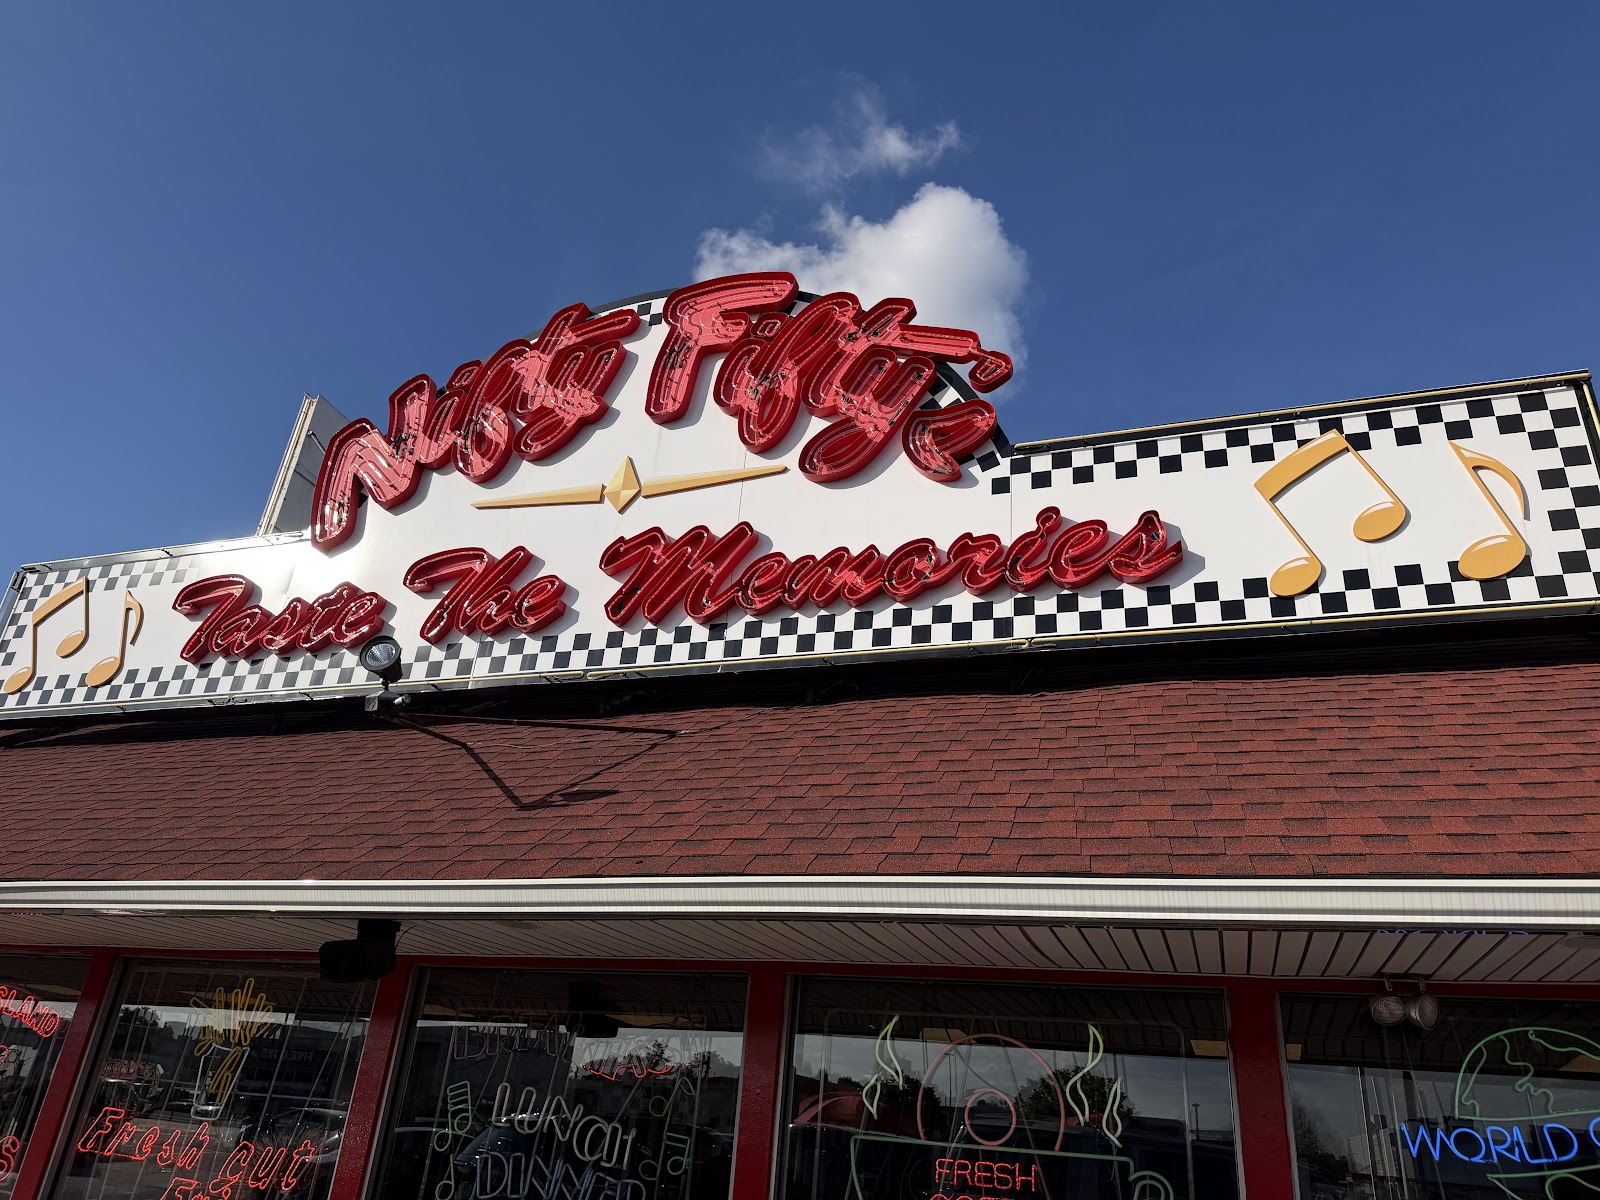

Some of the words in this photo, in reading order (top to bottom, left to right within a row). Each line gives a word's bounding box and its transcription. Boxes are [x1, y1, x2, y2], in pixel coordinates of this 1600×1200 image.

[311, 302, 641, 553] Nifty
[645, 271, 1014, 483] Fifty's
[172, 574, 386, 664] Taste
[403, 545, 567, 646] The
[599, 506, 1184, 627] Memories
[77, 1107, 210, 1170] Fresh
[492, 1082, 637, 1171] LUNCH
[1401, 1122, 1579, 1164] WORLD
[934, 1158, 1037, 1192] FRESH
